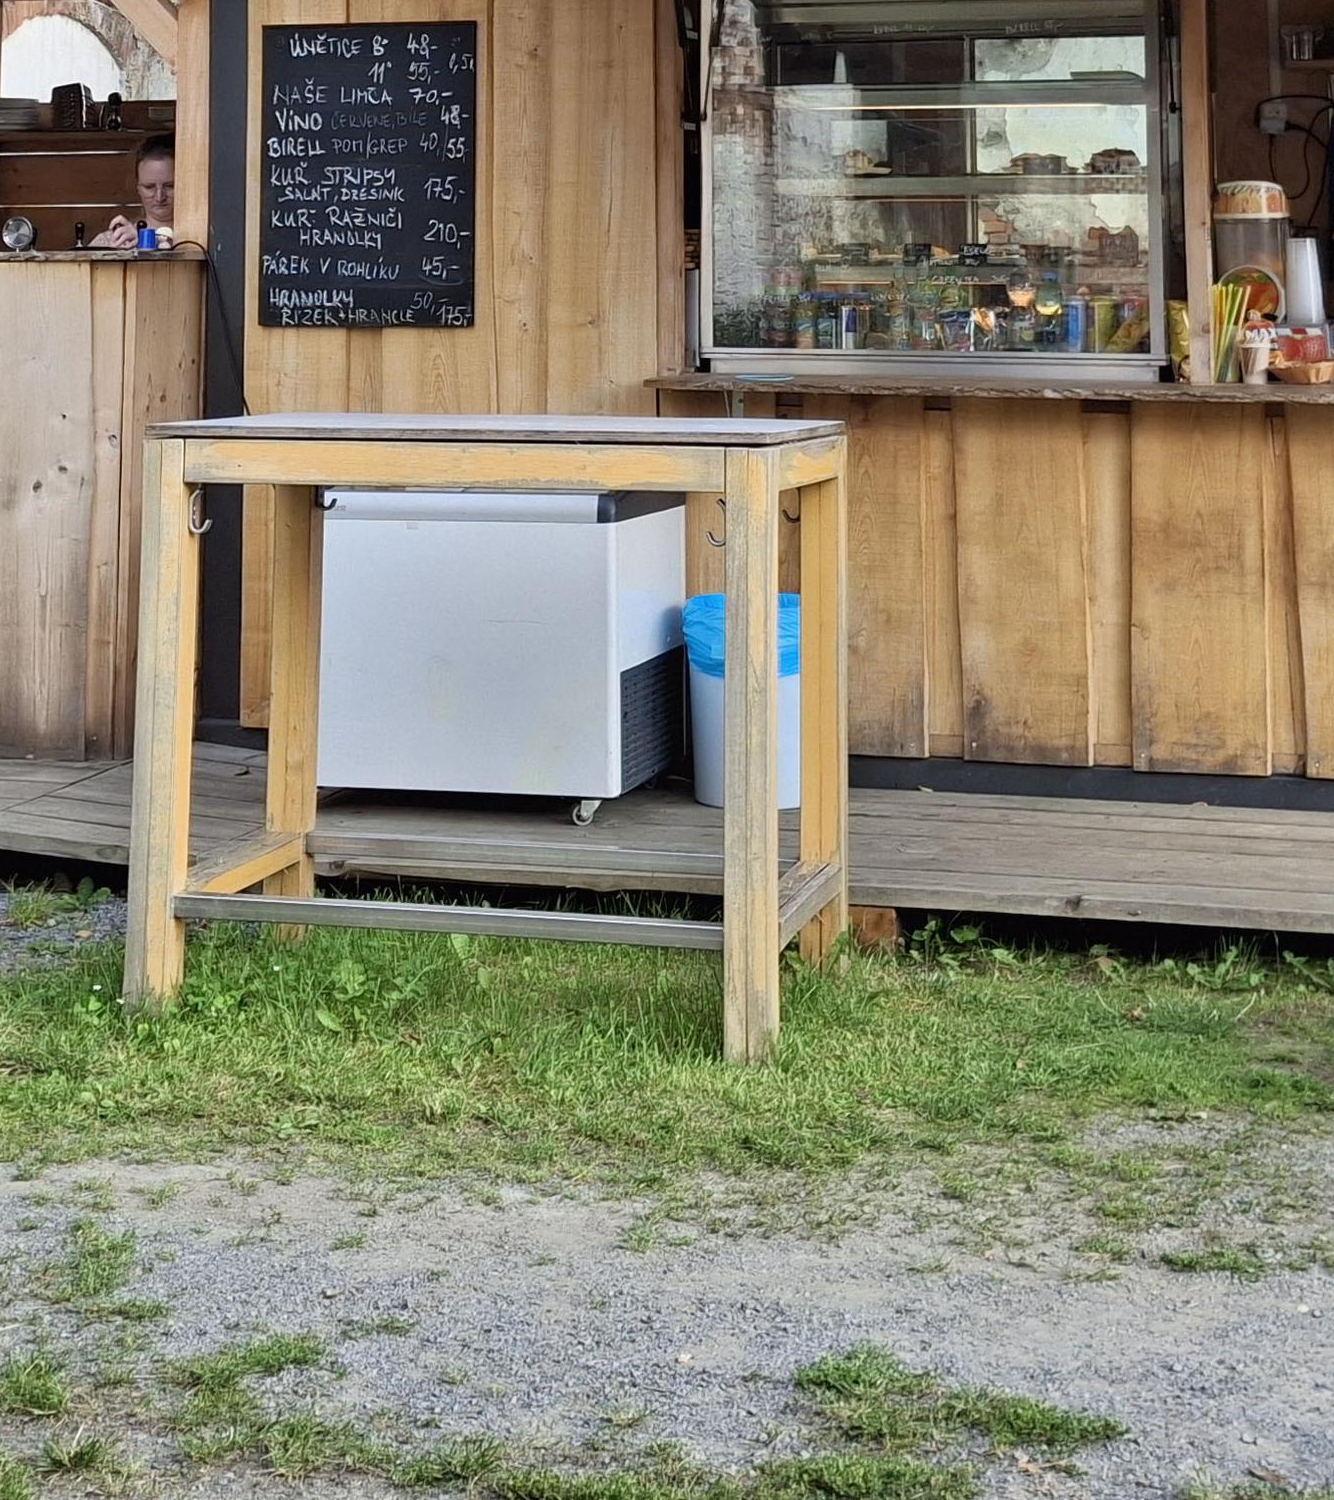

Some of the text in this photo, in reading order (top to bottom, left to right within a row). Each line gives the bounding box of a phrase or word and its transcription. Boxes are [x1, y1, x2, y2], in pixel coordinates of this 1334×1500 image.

[290, 32, 364, 58] ÚNĚTICE
[272, 76, 329, 106] NAŠE
[408, 87, 454, 106] 70,-
[266, 136, 327, 158] BIRELL
[321, 165, 396, 187] STRIPSY
[423, 175, 467, 205] 175,-
[325, 205, 403, 230] RAŽNIČI
[299, 219, 471, 251] HRANOLKY 210,-
[262, 250, 461, 281] PÁREK V ROHLÍKU 45,-
[269, 286, 355, 309] HRANOLKY
